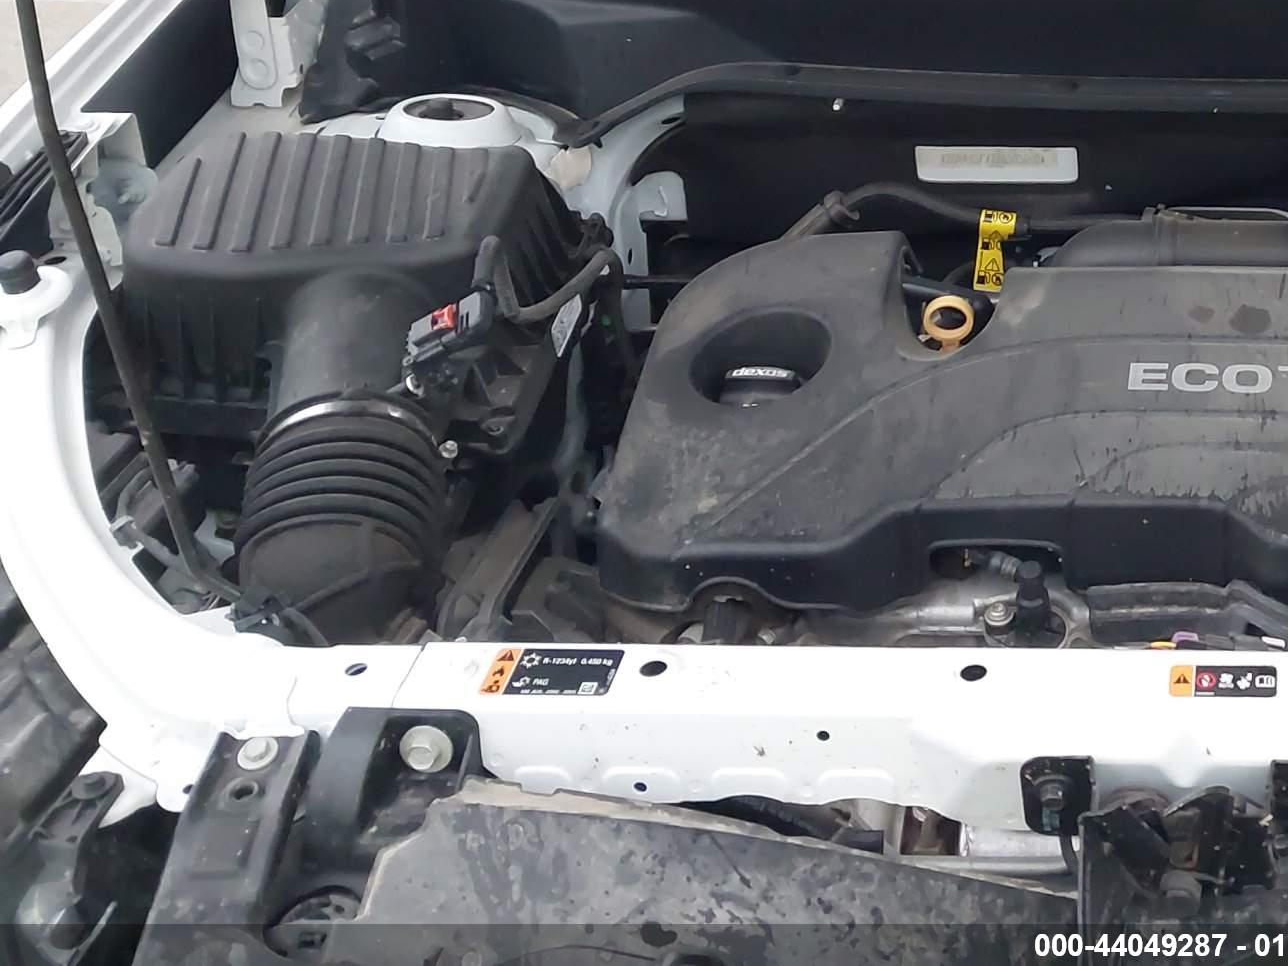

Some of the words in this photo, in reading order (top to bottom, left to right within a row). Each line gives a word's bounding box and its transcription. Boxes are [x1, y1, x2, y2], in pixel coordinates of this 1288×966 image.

[732, 367, 788, 378] dexos
[602, 658, 614, 667] kg
[532, 677, 550, 686] PAG
